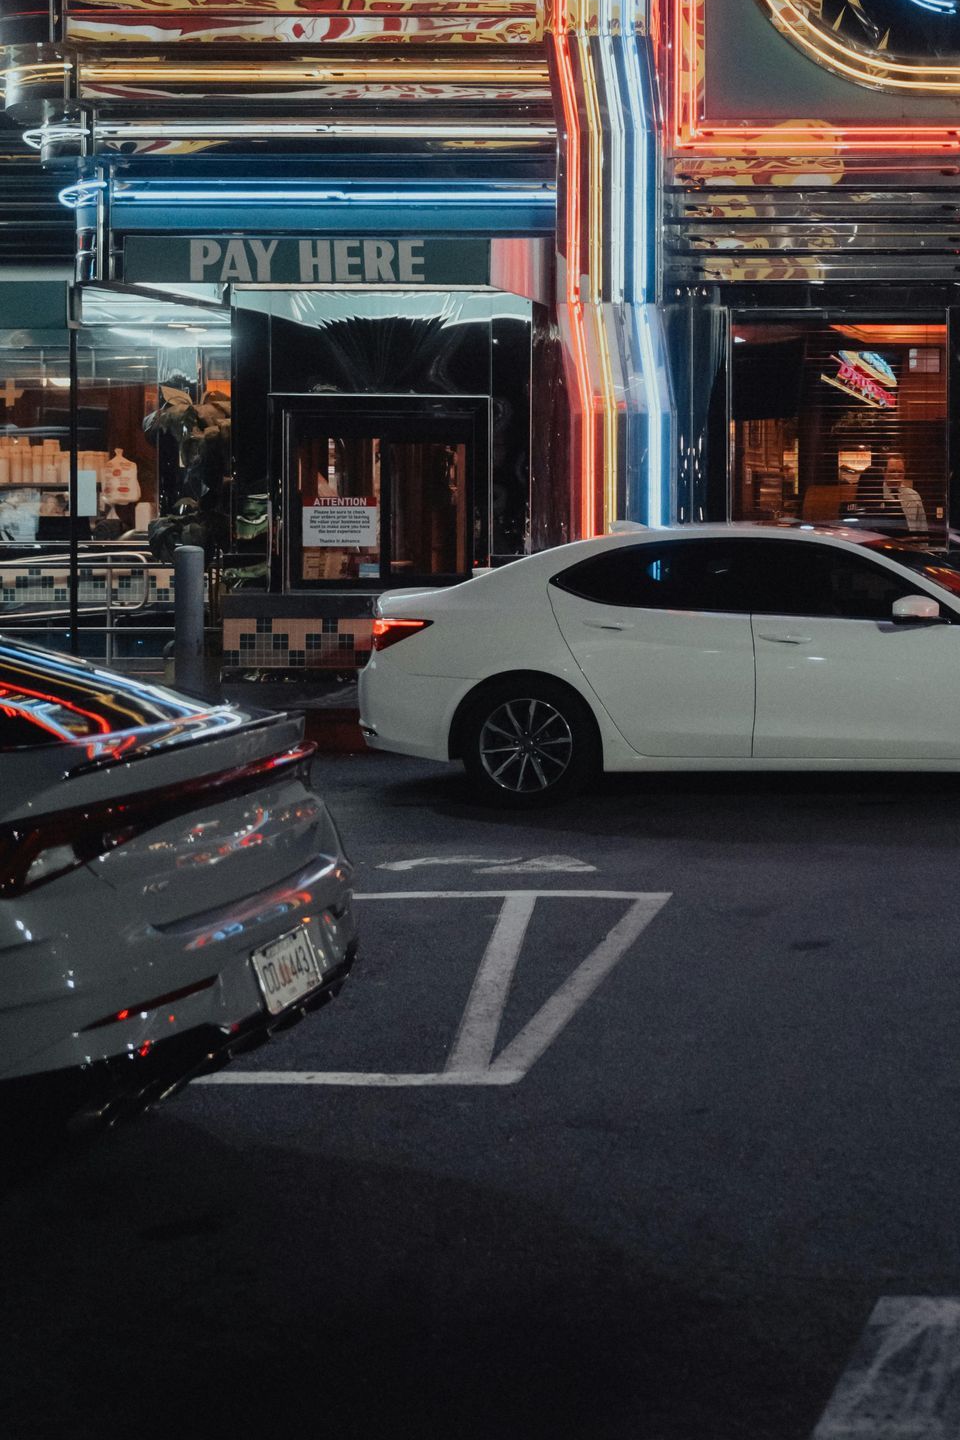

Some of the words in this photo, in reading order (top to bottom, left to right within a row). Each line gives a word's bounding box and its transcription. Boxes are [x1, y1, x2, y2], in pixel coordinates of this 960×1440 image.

[190, 240, 279, 282] PAY
[298, 240, 425, 282] HERE
[314, 498, 367, 506] ATTENTION
